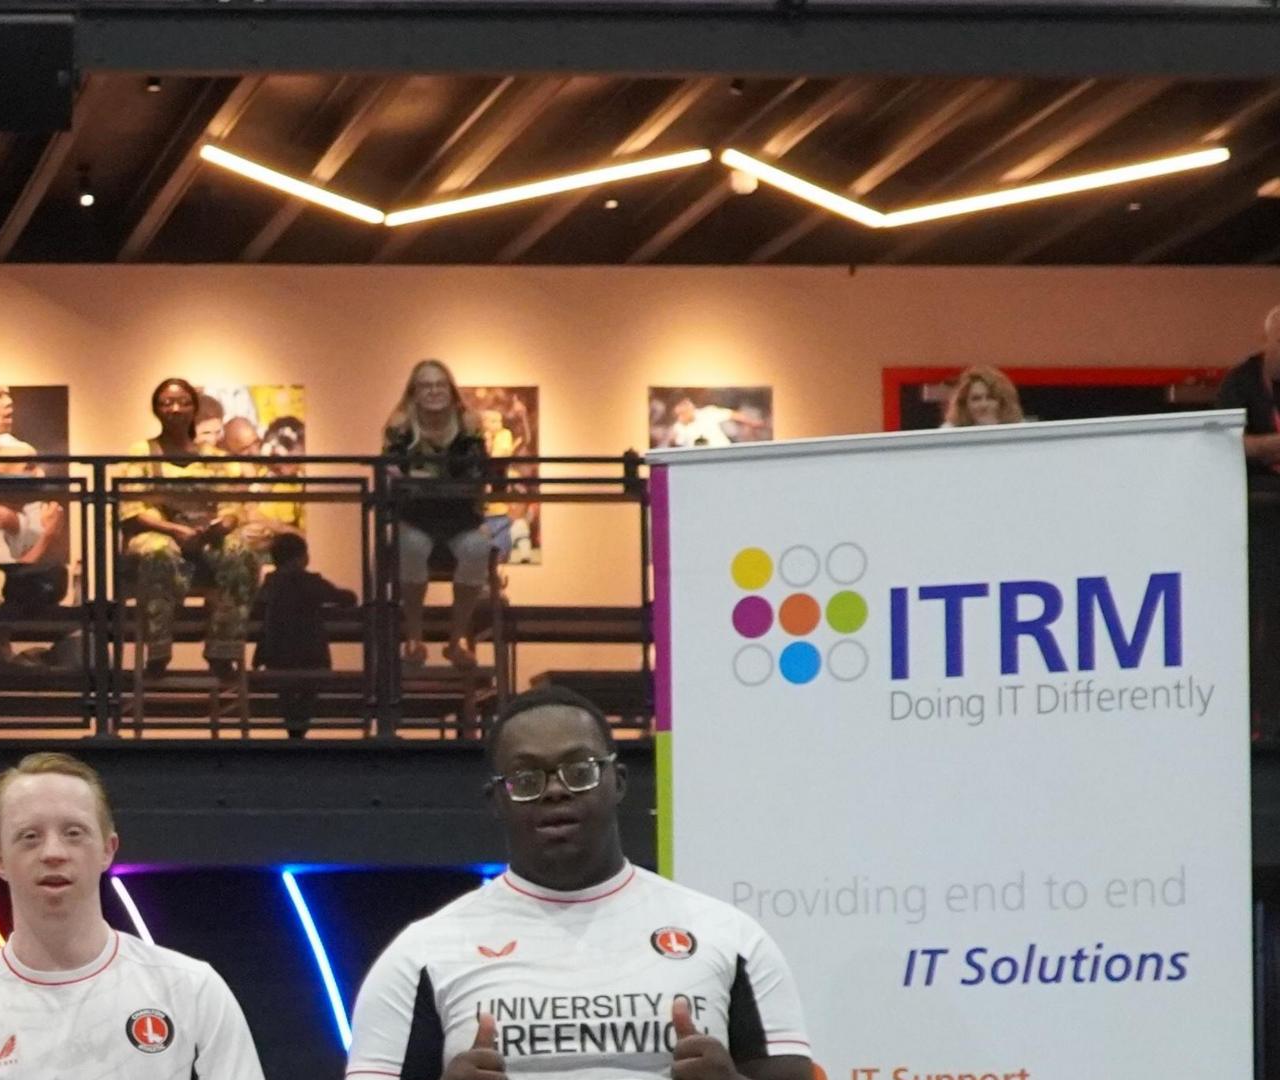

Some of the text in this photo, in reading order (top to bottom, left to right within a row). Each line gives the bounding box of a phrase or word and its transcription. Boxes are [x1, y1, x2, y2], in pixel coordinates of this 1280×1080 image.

[890, 572, 1183, 680] ITRM
[891, 674, 1216, 727] Doing IT Differently
[731, 865, 1187, 924] Providing end to end
[902, 942, 1189, 987] IT Solutions
[477, 993, 663, 1023] UNIVERSITY
[494, 1021, 708, 1056] REENWIC
